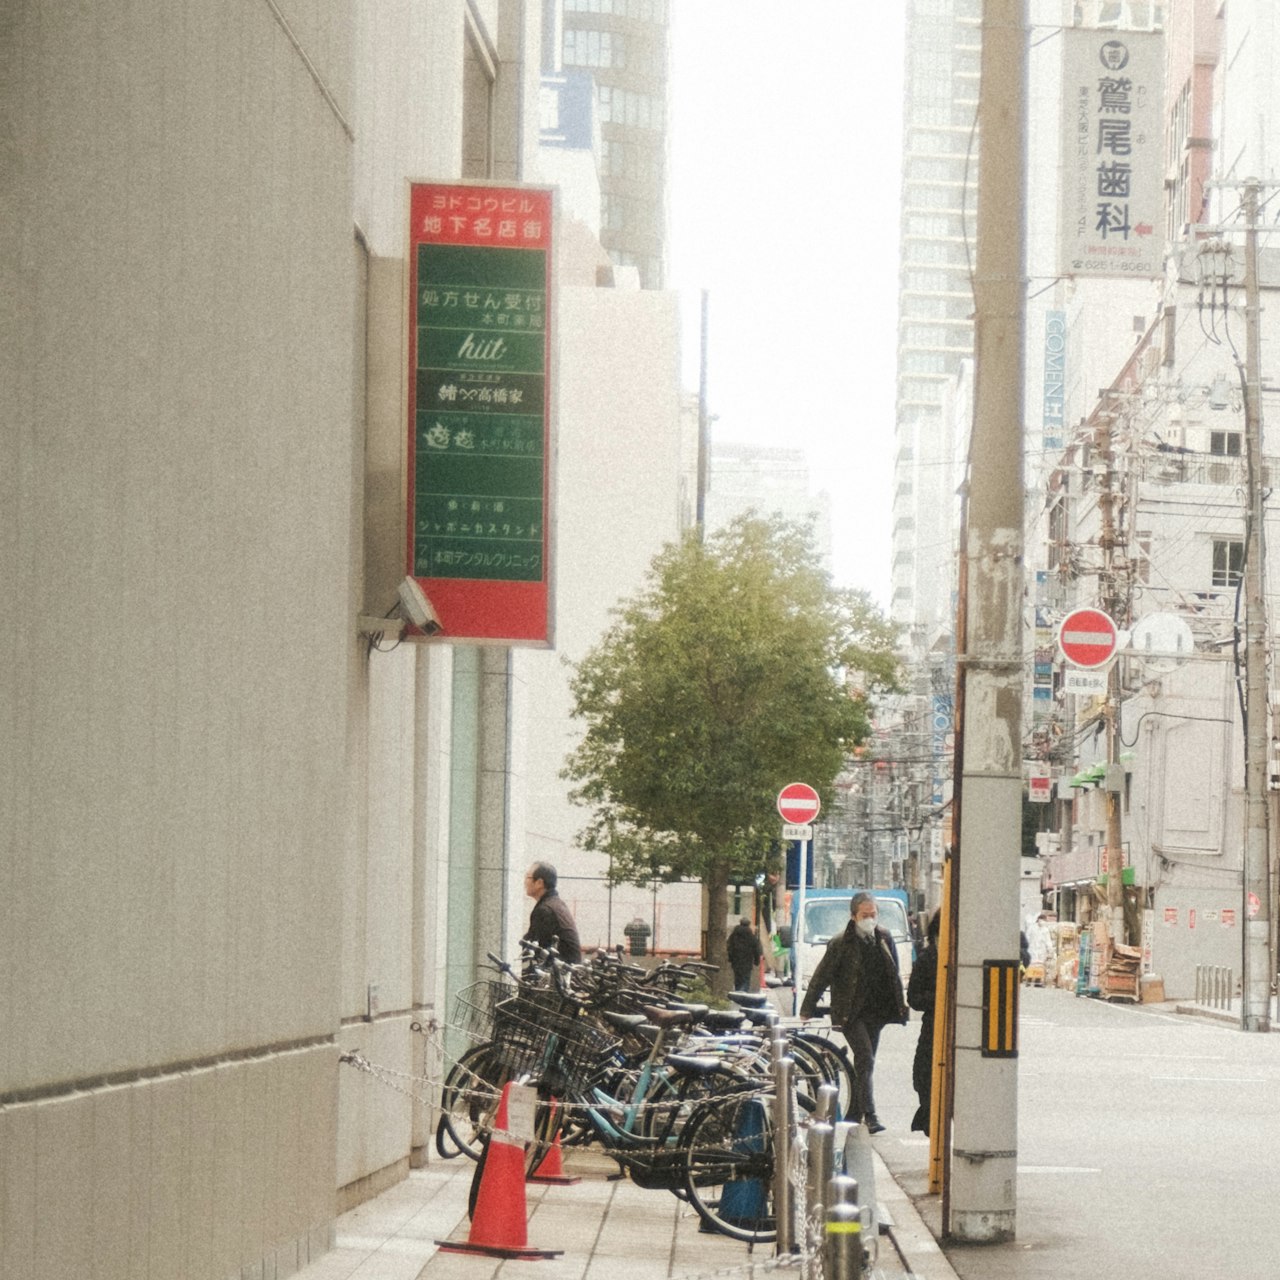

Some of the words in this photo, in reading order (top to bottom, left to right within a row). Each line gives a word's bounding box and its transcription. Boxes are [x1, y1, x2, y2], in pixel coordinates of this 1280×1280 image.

[1096, 77, 1132, 240] 鷲尾歯科
[432, 195, 534, 214] ヨドコウビル
[423, 215, 542, 239] 地下名店街
[422, 290, 542, 312] 処方せん受付
